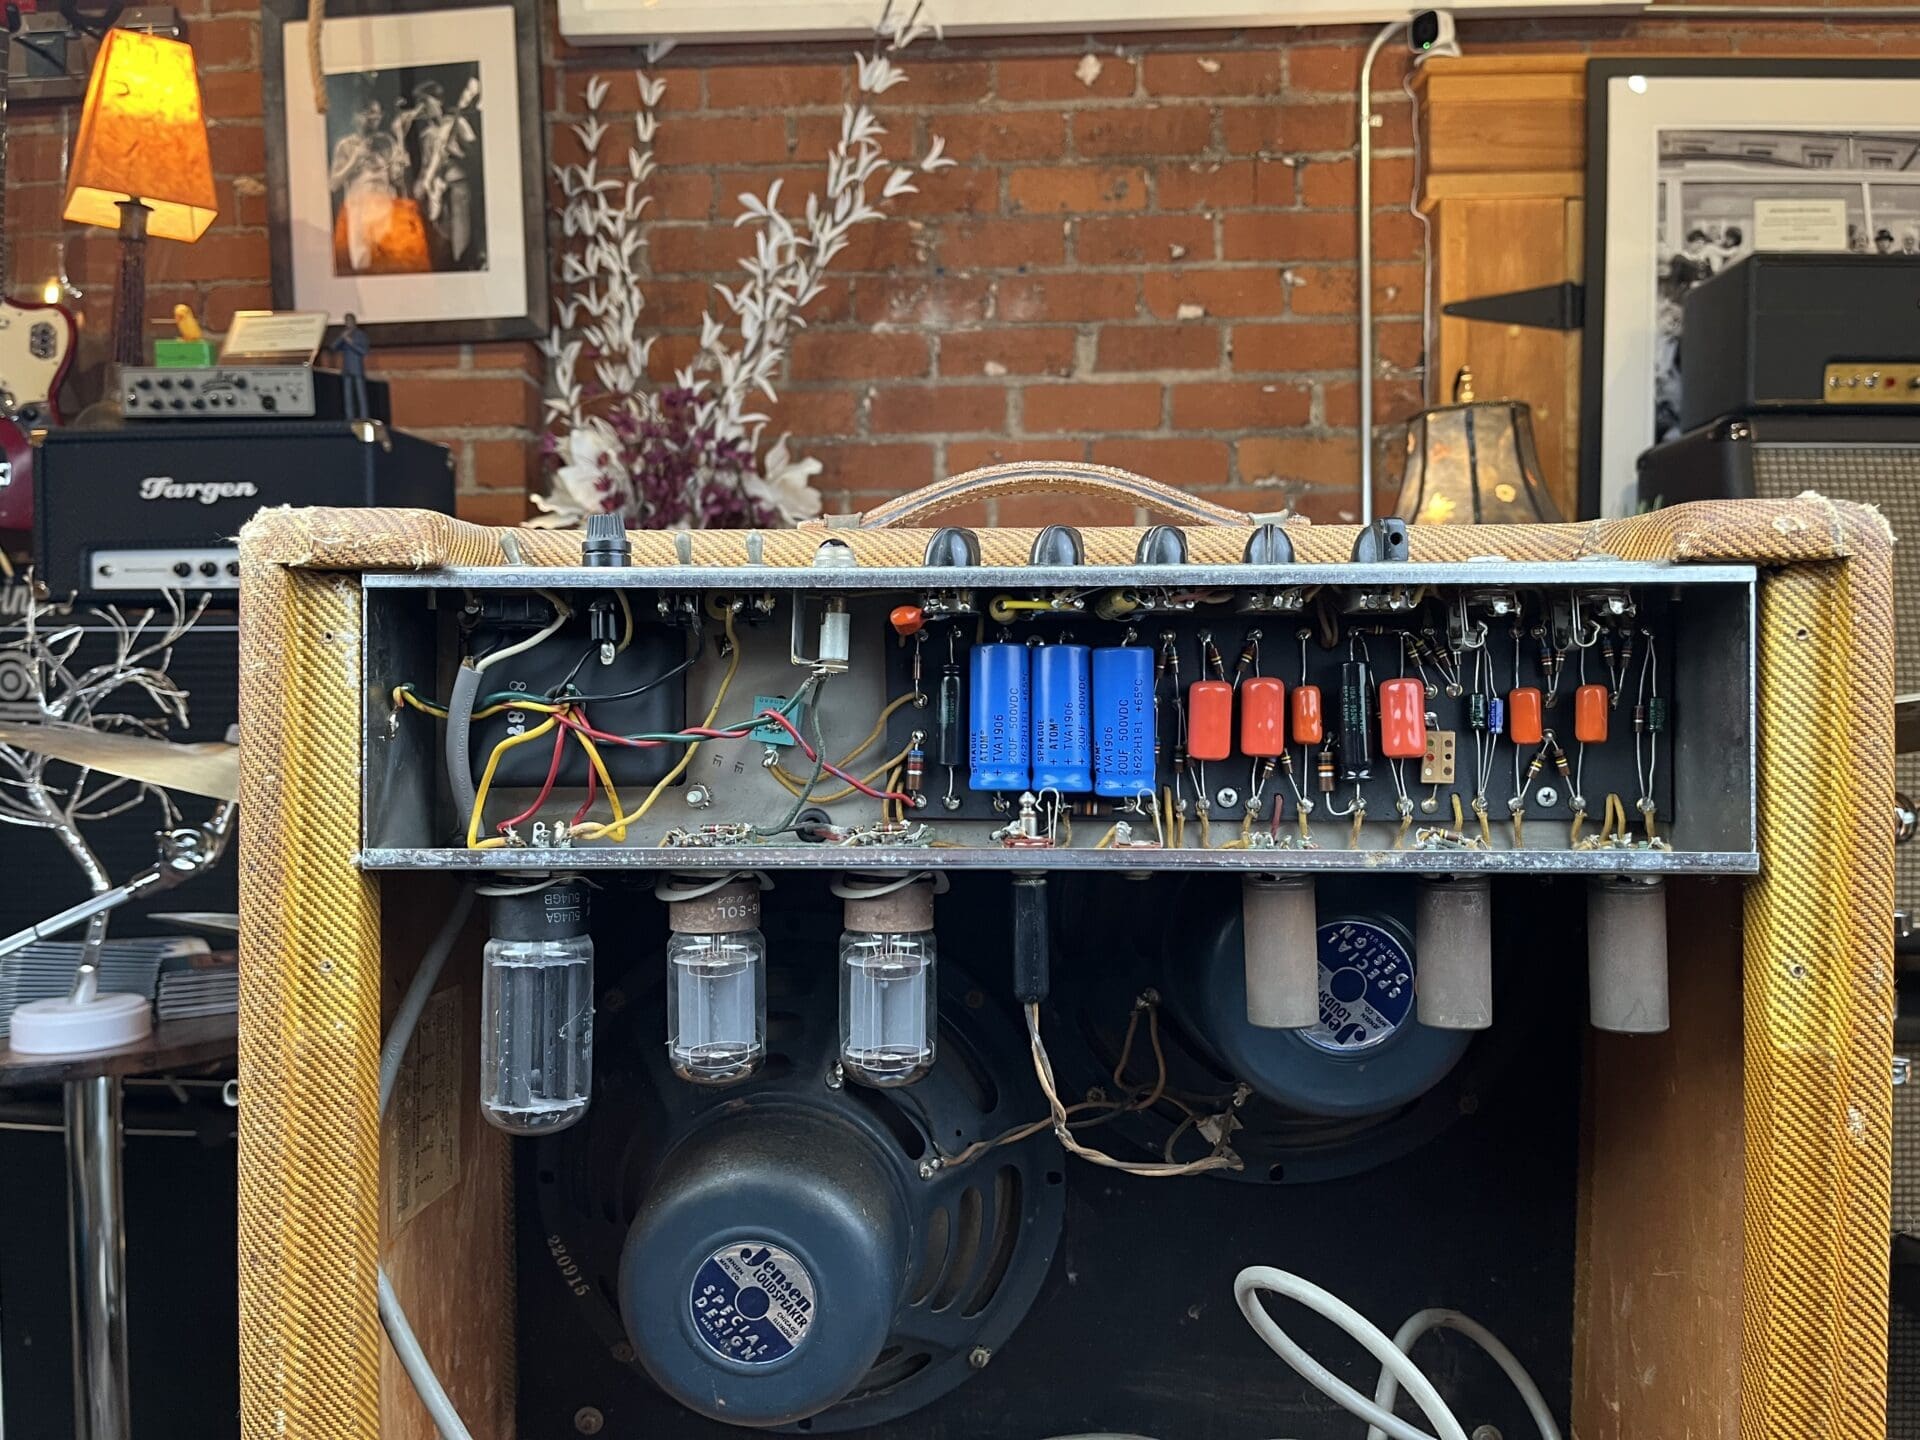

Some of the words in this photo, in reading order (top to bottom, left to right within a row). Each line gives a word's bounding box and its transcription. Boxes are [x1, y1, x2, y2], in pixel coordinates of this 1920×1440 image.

[140, 476, 258, 504] Fargen
[1008, 687, 1019, 729] 500VDC
[1134, 679, 1143, 713] +65°C
[992, 714, 1004, 763] TVA1906
[1037, 719, 1045, 762] SPRAGUE
[1063, 702, 1074, 750] TVA1906
[1118, 699, 1129, 742] 500VDC
[1008, 737, 1018, 764] 20UF
[1104, 726, 1113, 775] TVA1906
[1118, 750, 1129, 776] 20UF
[1133, 721, 1143, 776] 9622H181
[544, 892, 580, 905] 5U4GB
[545, 910, 580, 923] 5U4GA
[1328, 932, 1402, 999] SPECIAL
[1339, 925, 1409, 985] DESIGN
[1319, 1003, 1366, 1045] Jen
[727, 1257, 745, 1276] JENSEN
[740, 1247, 812, 1313] Jensen
[703, 1284, 768, 1355] SPECIAL
[752, 1268, 808, 1329] LOUDSPEAKER
[695, 1296, 757, 1360] DESIGN
[700, 1316, 714, 1332] MADE
[772, 1317, 794, 1340] ILLINOIS
[776, 1312, 799, 1336] CHICAGO
